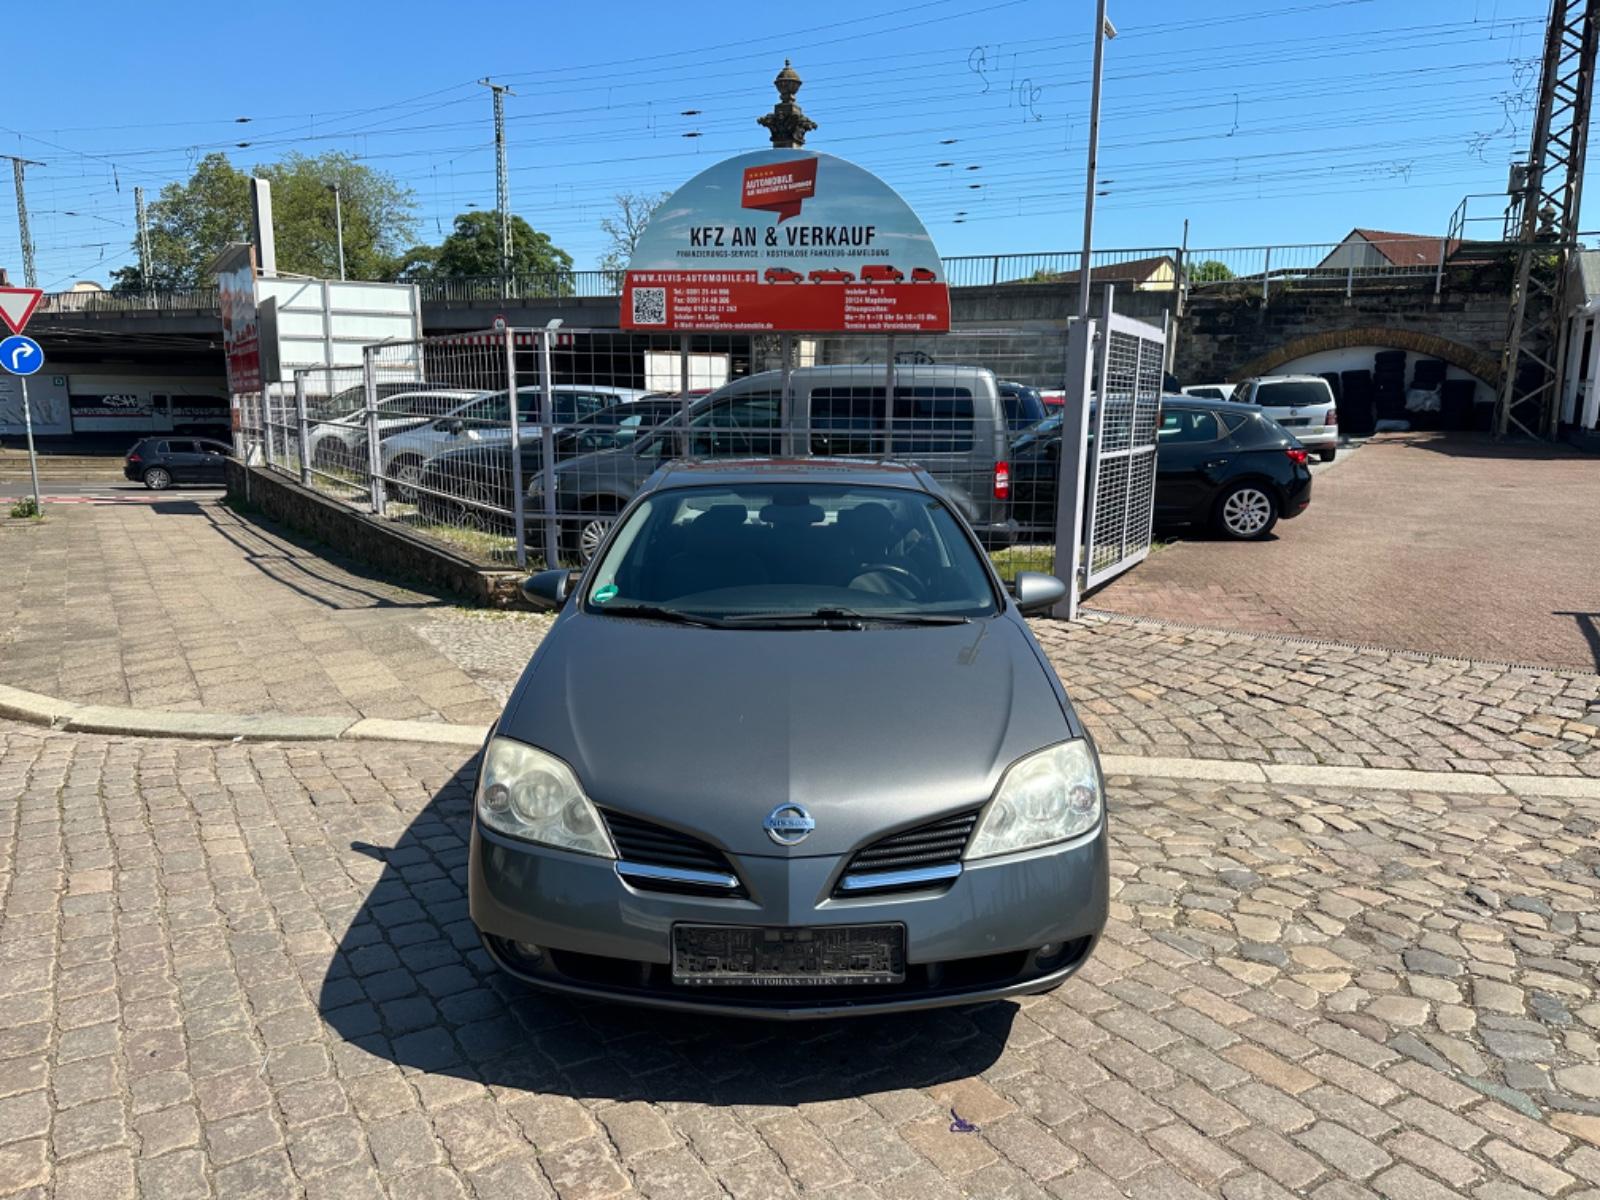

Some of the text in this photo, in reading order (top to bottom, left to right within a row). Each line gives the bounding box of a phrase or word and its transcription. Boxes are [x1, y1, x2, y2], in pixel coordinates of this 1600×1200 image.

[746, 174, 793, 189] AUTOMOBILE
[691, 226, 876, 247] KFZ AN & VERKAUF
[766, 249, 808, 258] KOSTENLOSE
[632, 273, 756, 283] WWW.ELVIS-AUTOMOBILE.DE
